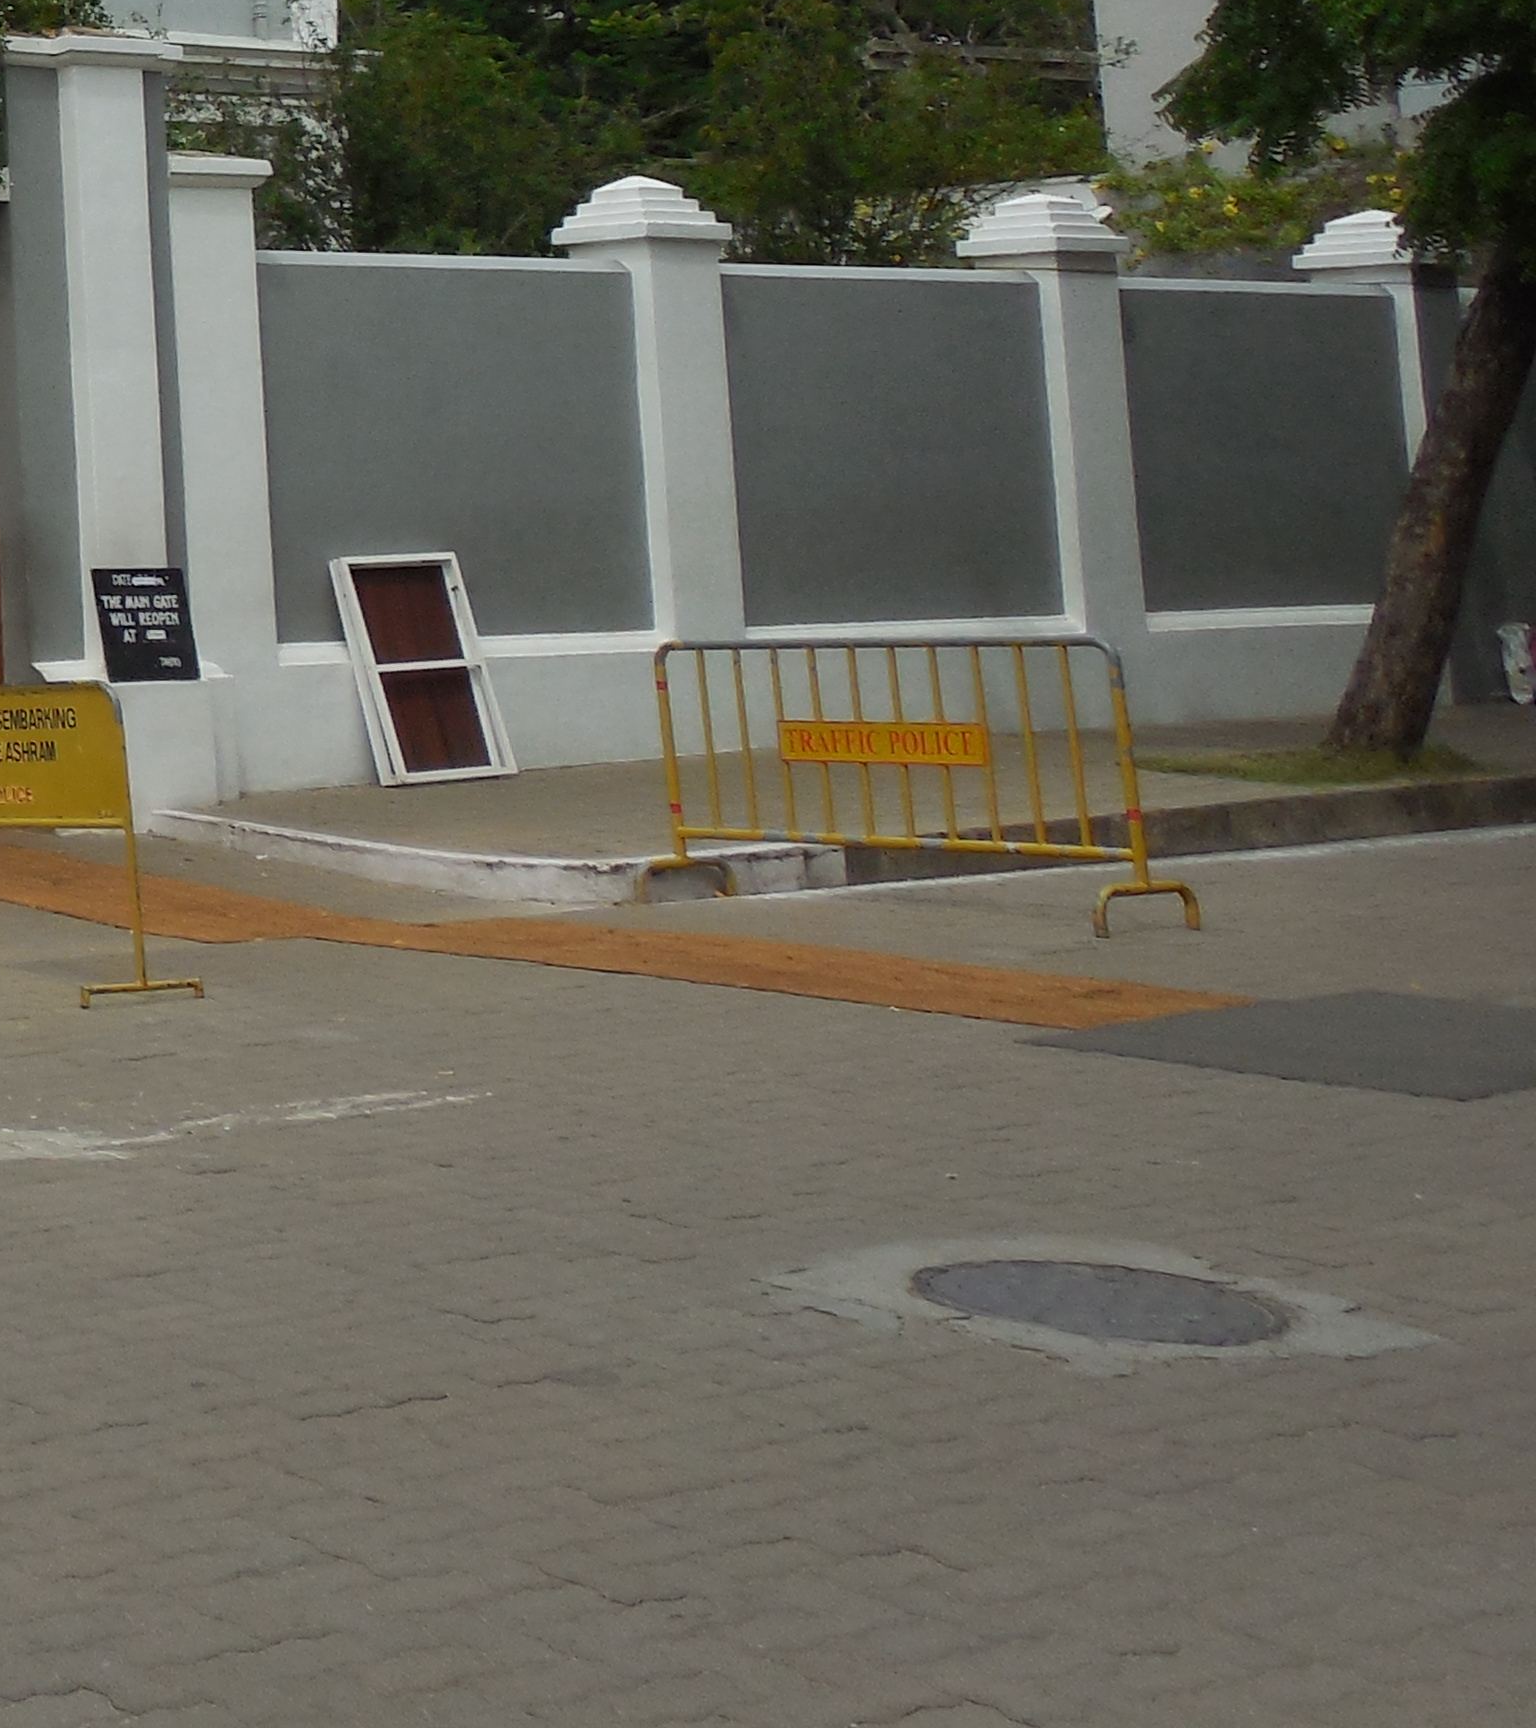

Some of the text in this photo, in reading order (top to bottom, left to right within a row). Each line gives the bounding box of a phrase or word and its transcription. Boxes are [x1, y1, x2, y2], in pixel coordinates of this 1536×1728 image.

[99, 594, 179, 610] THE MAIN GATE
[109, 612, 180, 626] WILL REOPEN
[123, 628, 137, 643] AT
[784, 728, 976, 756] TRAFFIC POLICE
[5, 740, 57, 763] ASHRAM
